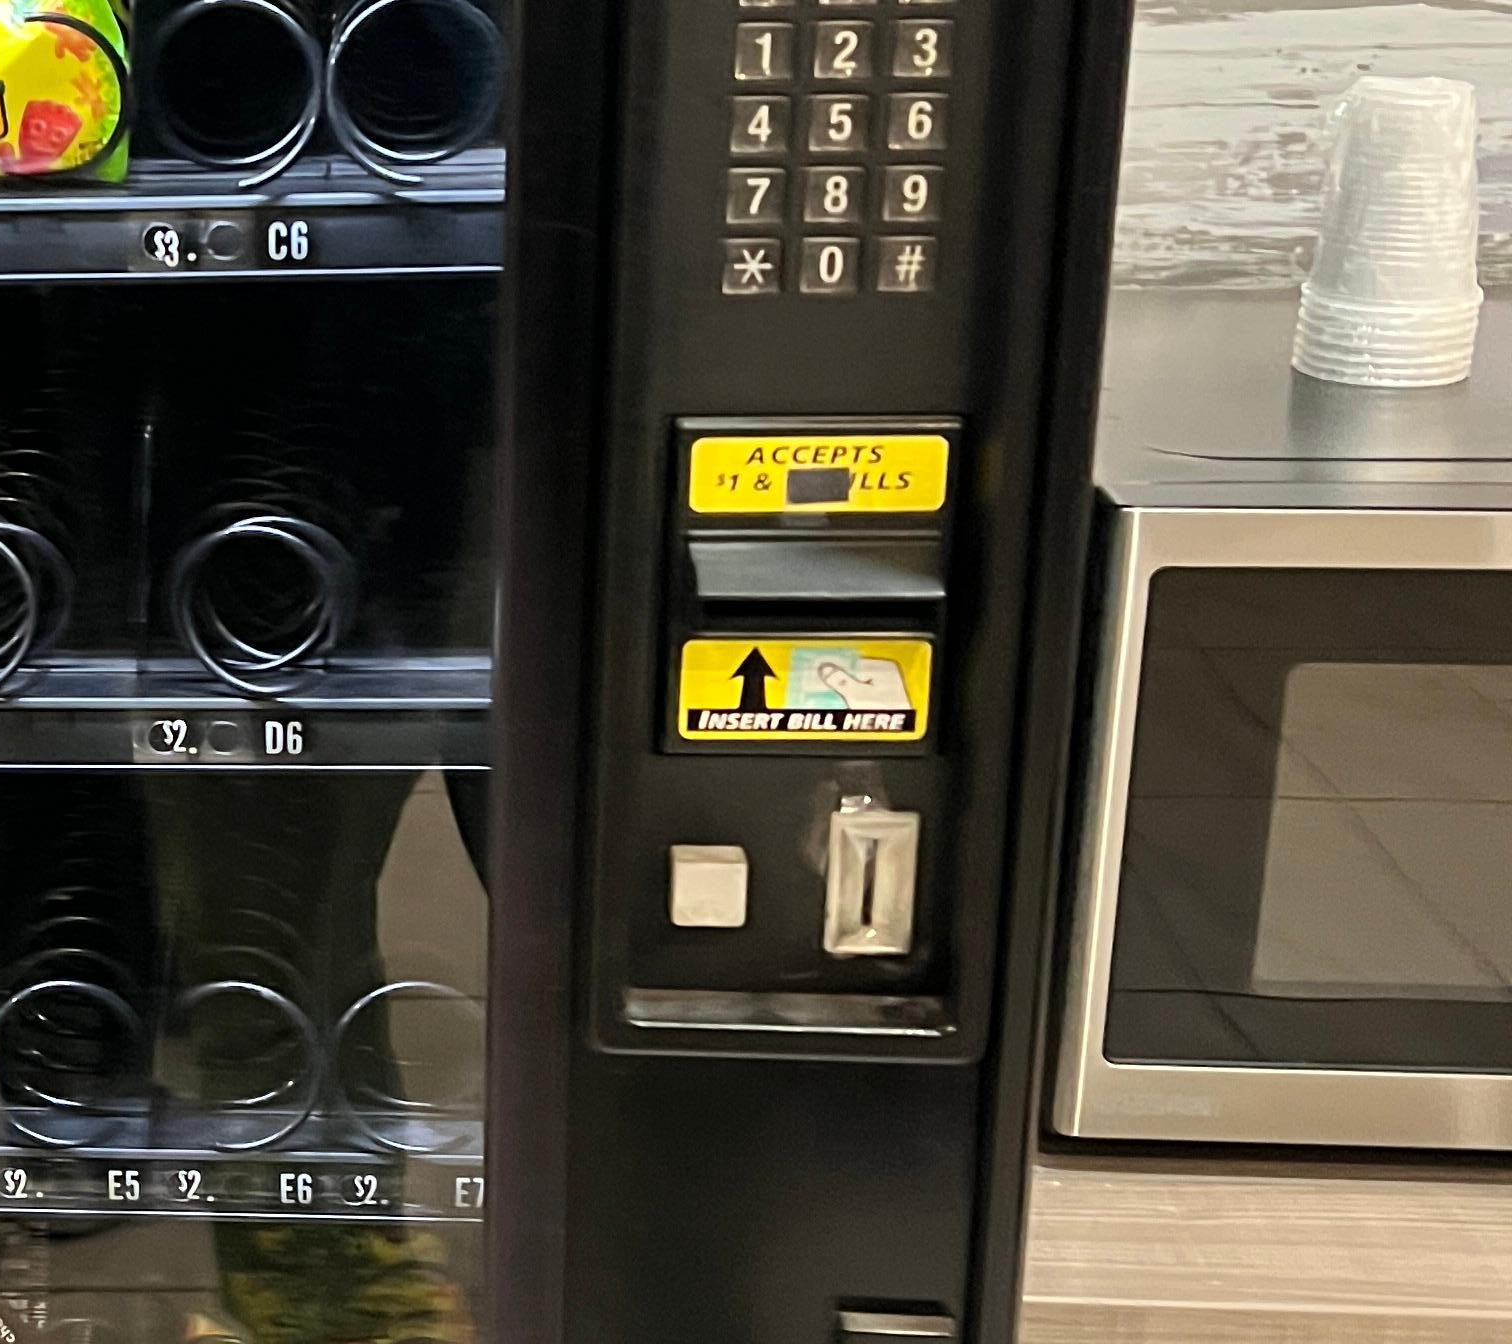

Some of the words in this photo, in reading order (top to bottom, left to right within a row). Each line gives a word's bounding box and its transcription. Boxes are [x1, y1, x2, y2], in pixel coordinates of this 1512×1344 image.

[754, 32, 773, 73] 1
[833, 30, 859, 70] 2
[912, 28, 938, 68] 3
[748, 105, 772, 142] 4
[828, 103, 853, 141] 5
[907, 100, 933, 139] 6
[746, 177, 771, 214] 7
[823, 175, 848, 213] 8
[902, 174, 928, 212] 9
[267, 221, 309, 260] C6
[819, 246, 844, 283] 0
[895, 244, 925, 285] #
[745, 444, 886, 466] ACCEPTS
[716, 473, 740, 492] $1
[753, 473, 773, 492] &
[849, 470, 913, 491] ILLS
[697, 710, 786, 731] INSERT
[787, 712, 838, 731] BILL
[842, 711, 907, 731] HERE
[264, 721, 303, 756] D6
[108, 1169, 140, 1201] E5
[279, 1172, 313, 1205] E6
[455, 1176, 484, 1207] E7
